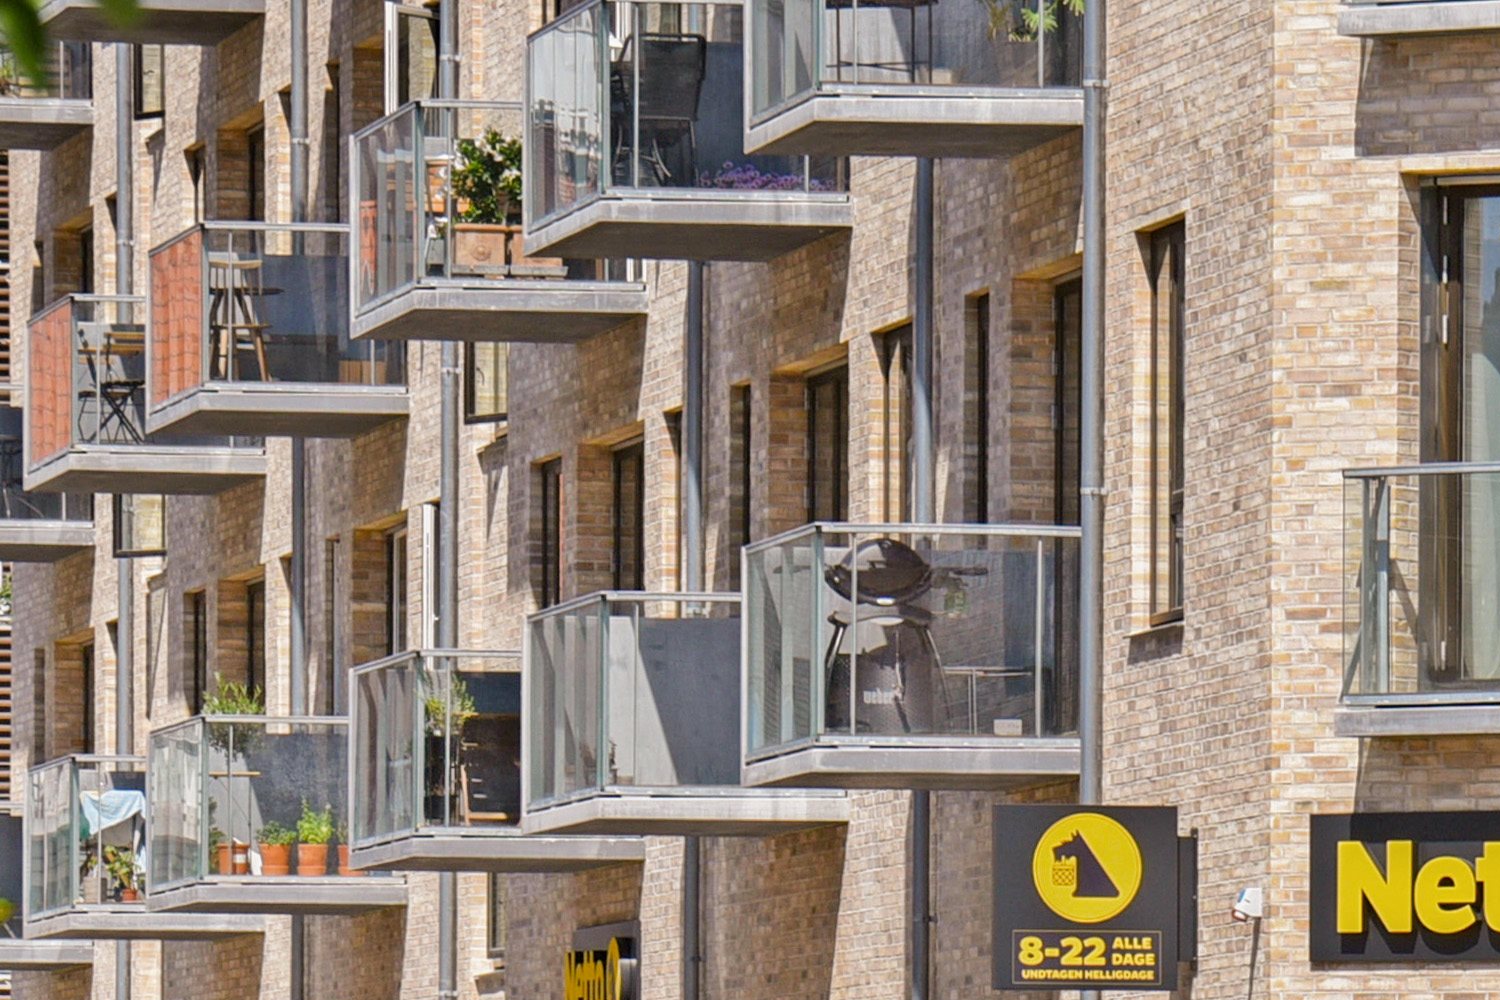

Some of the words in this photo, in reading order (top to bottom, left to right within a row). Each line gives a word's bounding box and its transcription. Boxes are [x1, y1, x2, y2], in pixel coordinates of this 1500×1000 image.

[1112, 937, 1152, 950] ALLE
[1018, 936, 1106, 966] 8-22
[1112, 953, 1155, 966] DAGE
[1022, 970, 1083, 979] UNDTAGEN
[1085, 970, 1154, 980] HELLIGDAGE
